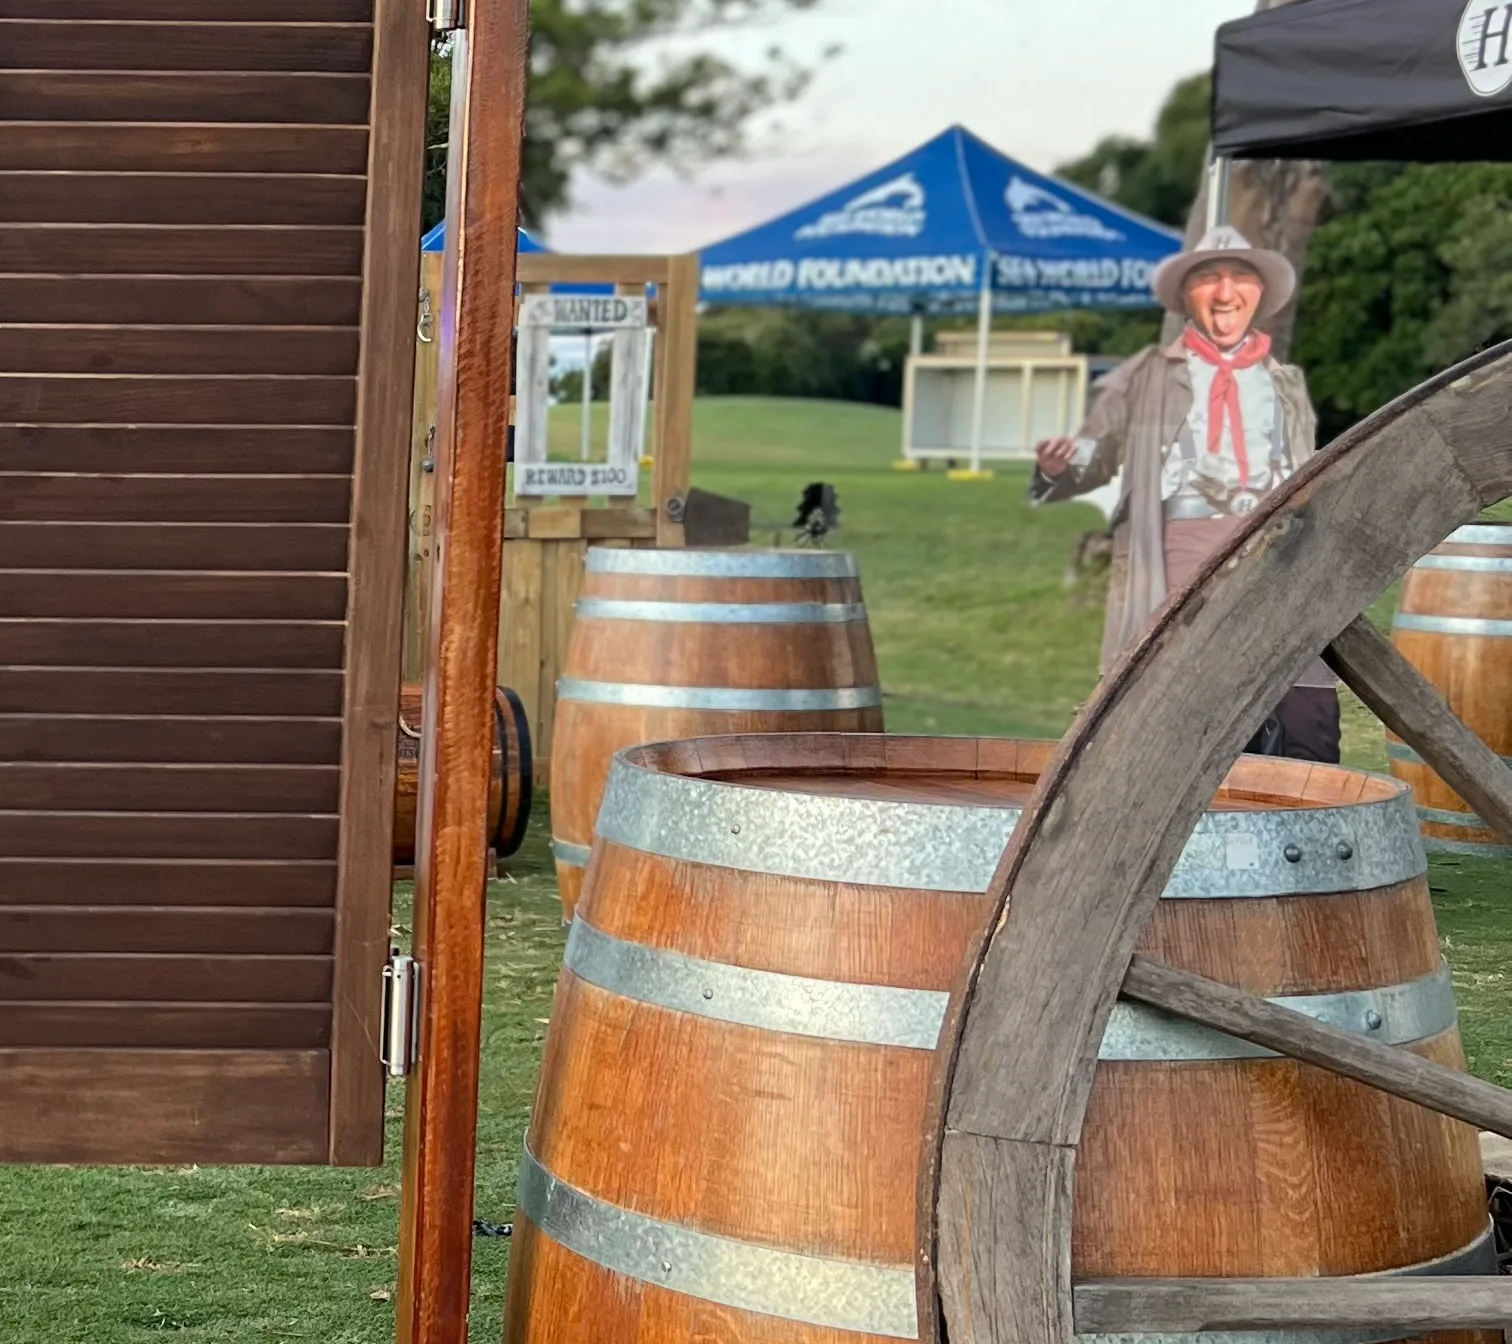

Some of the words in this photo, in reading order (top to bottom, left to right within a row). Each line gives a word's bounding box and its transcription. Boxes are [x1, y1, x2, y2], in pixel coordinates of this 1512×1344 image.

[796, 254, 977, 290] FOUNDATION
[552, 298, 628, 323] WANTED
[525, 467, 586, 486] REWARD
